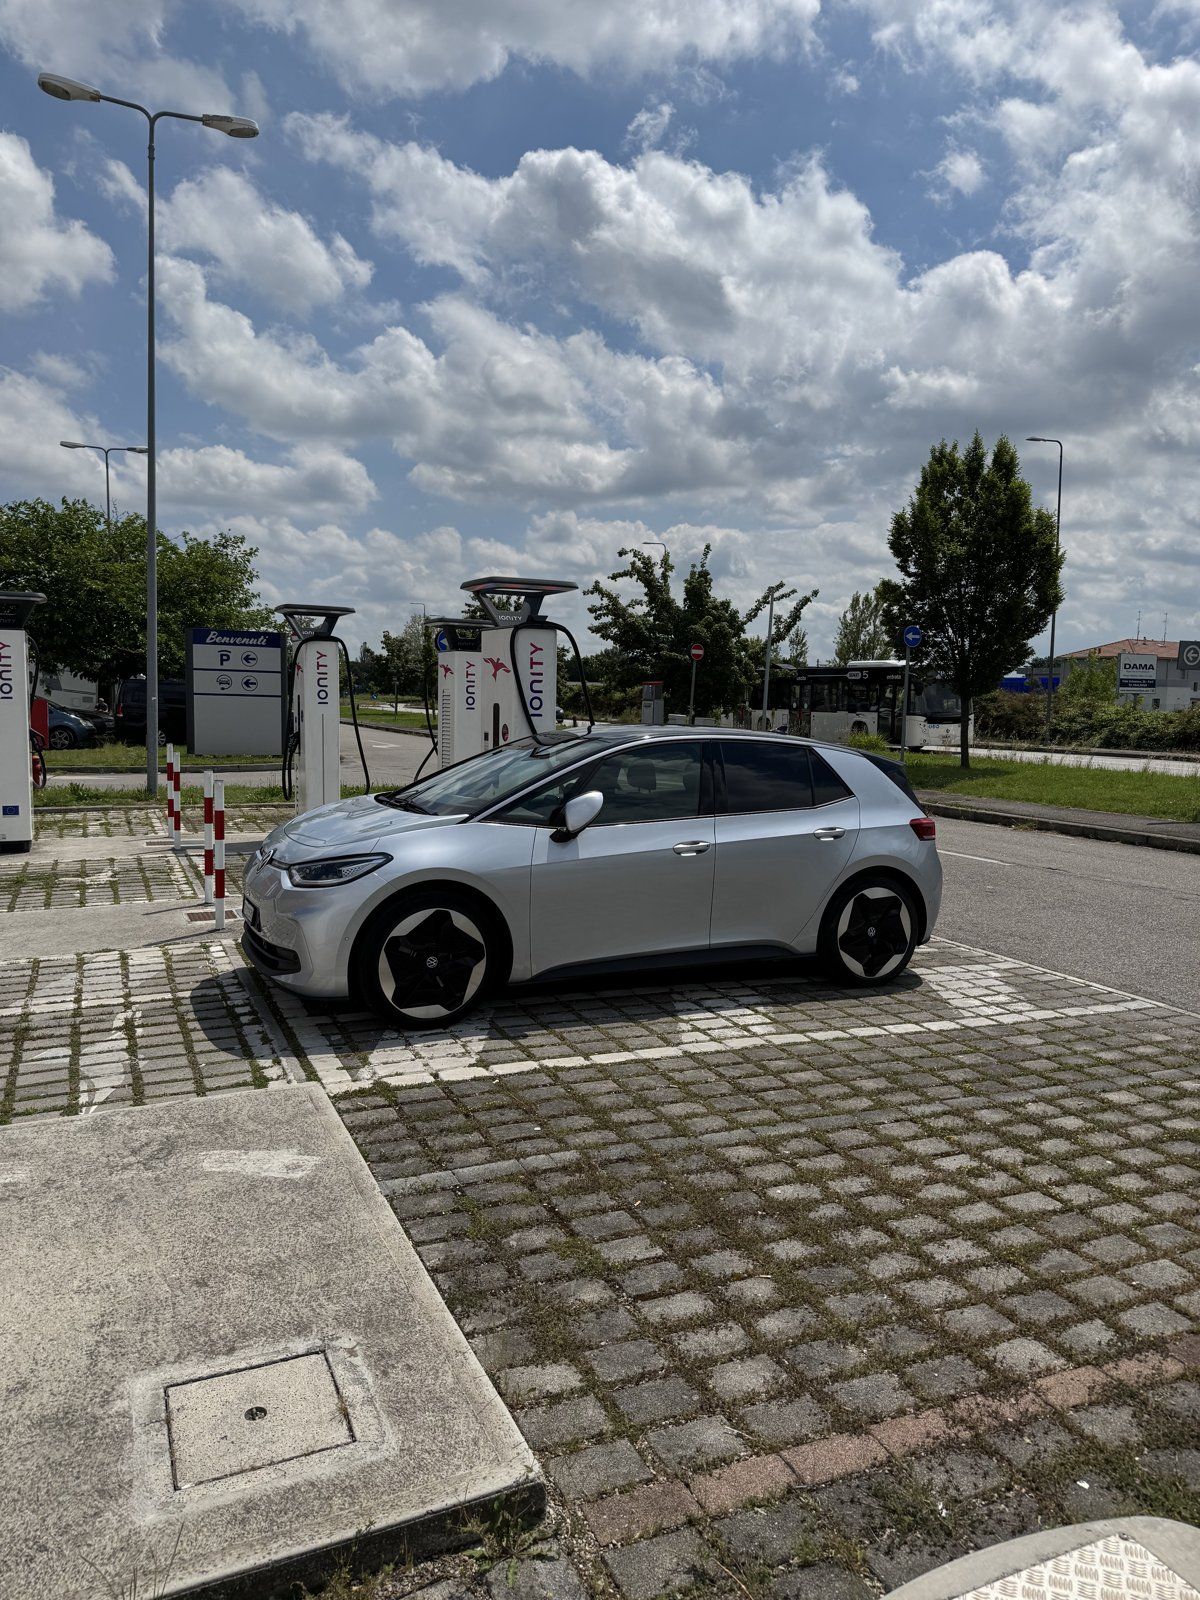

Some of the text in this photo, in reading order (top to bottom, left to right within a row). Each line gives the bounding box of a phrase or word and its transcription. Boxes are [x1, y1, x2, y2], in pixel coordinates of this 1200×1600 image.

[206, 631, 269, 645] Benvenuti
[220, 653, 231, 666] P
[0, 642, 13, 699] IONITY
[316, 650, 329, 704] IONITY
[465, 661, 476, 710] IONITY
[529, 642, 544, 717] IONITY
[862, 670, 869, 679] 5
